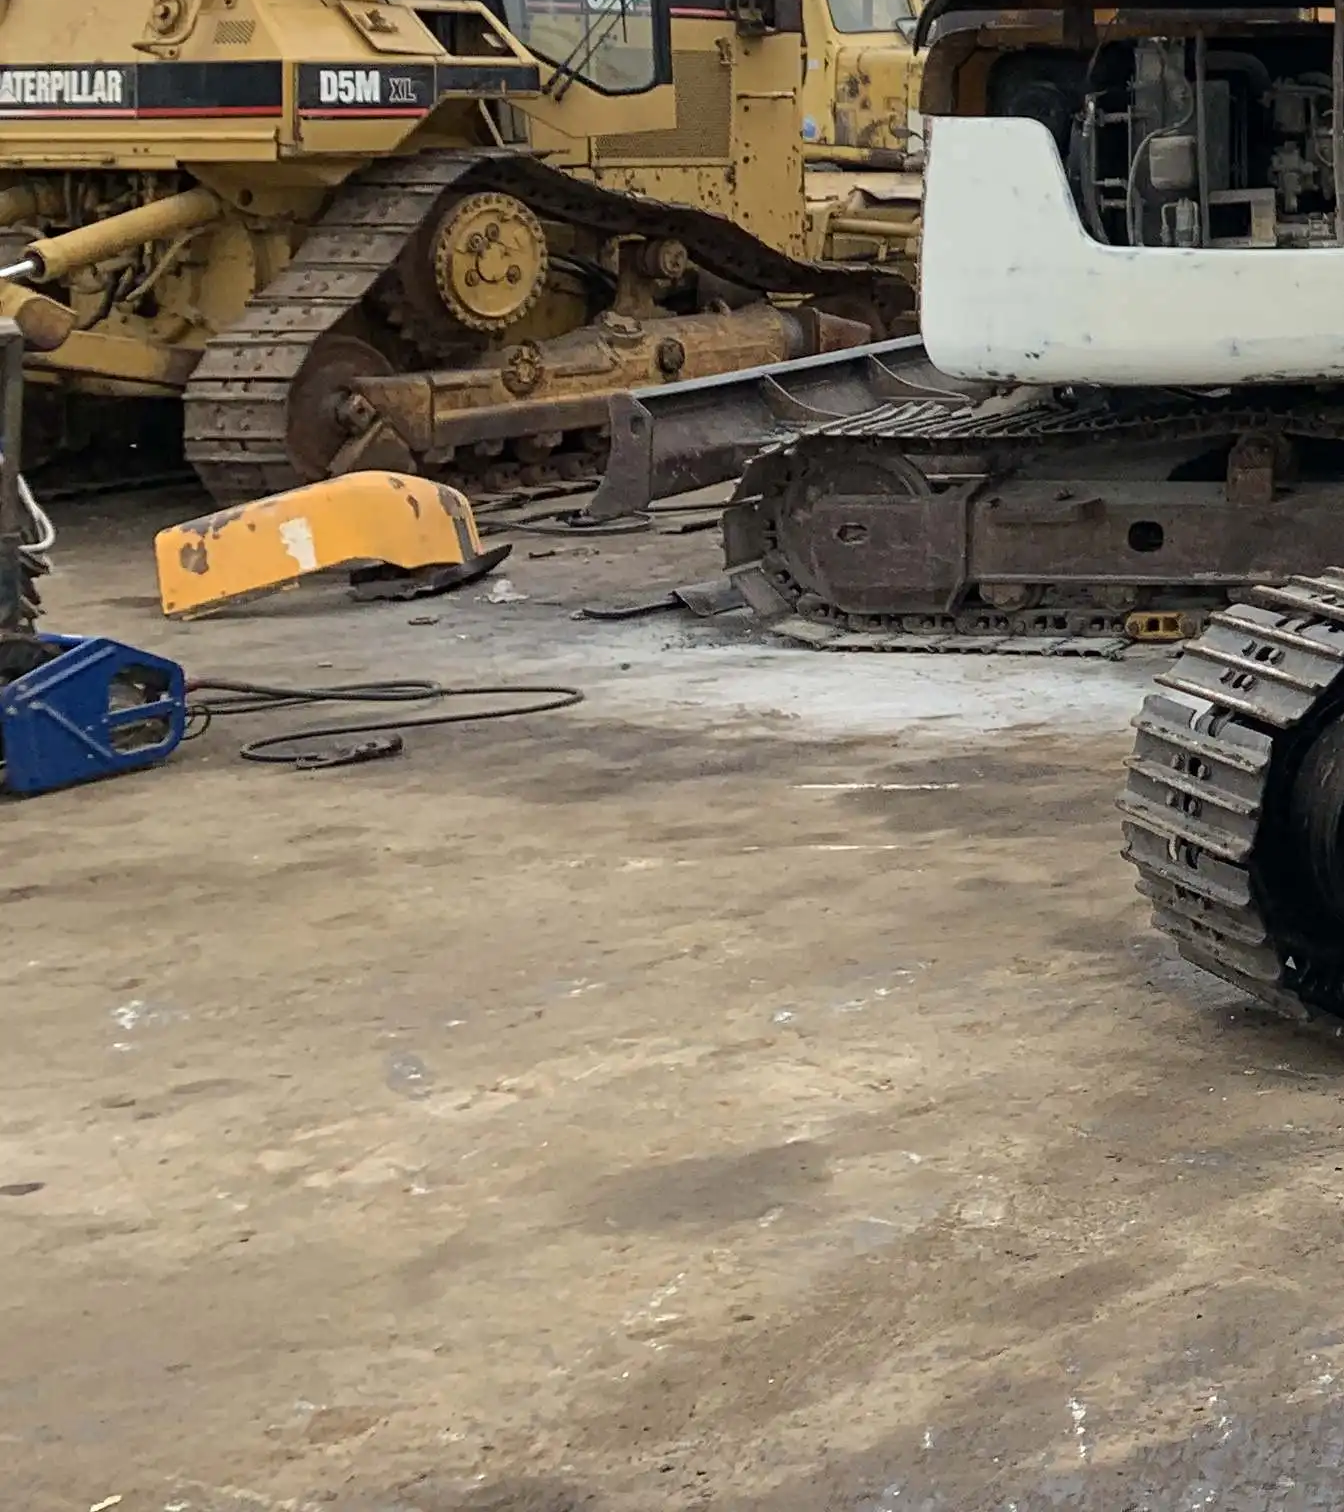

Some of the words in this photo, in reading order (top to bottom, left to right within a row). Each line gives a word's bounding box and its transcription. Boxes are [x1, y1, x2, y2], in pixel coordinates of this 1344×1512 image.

[0, 70, 122, 104] ATERPILLAR
[320, 70, 380, 103] D5M
[388, 77, 416, 103] XL
